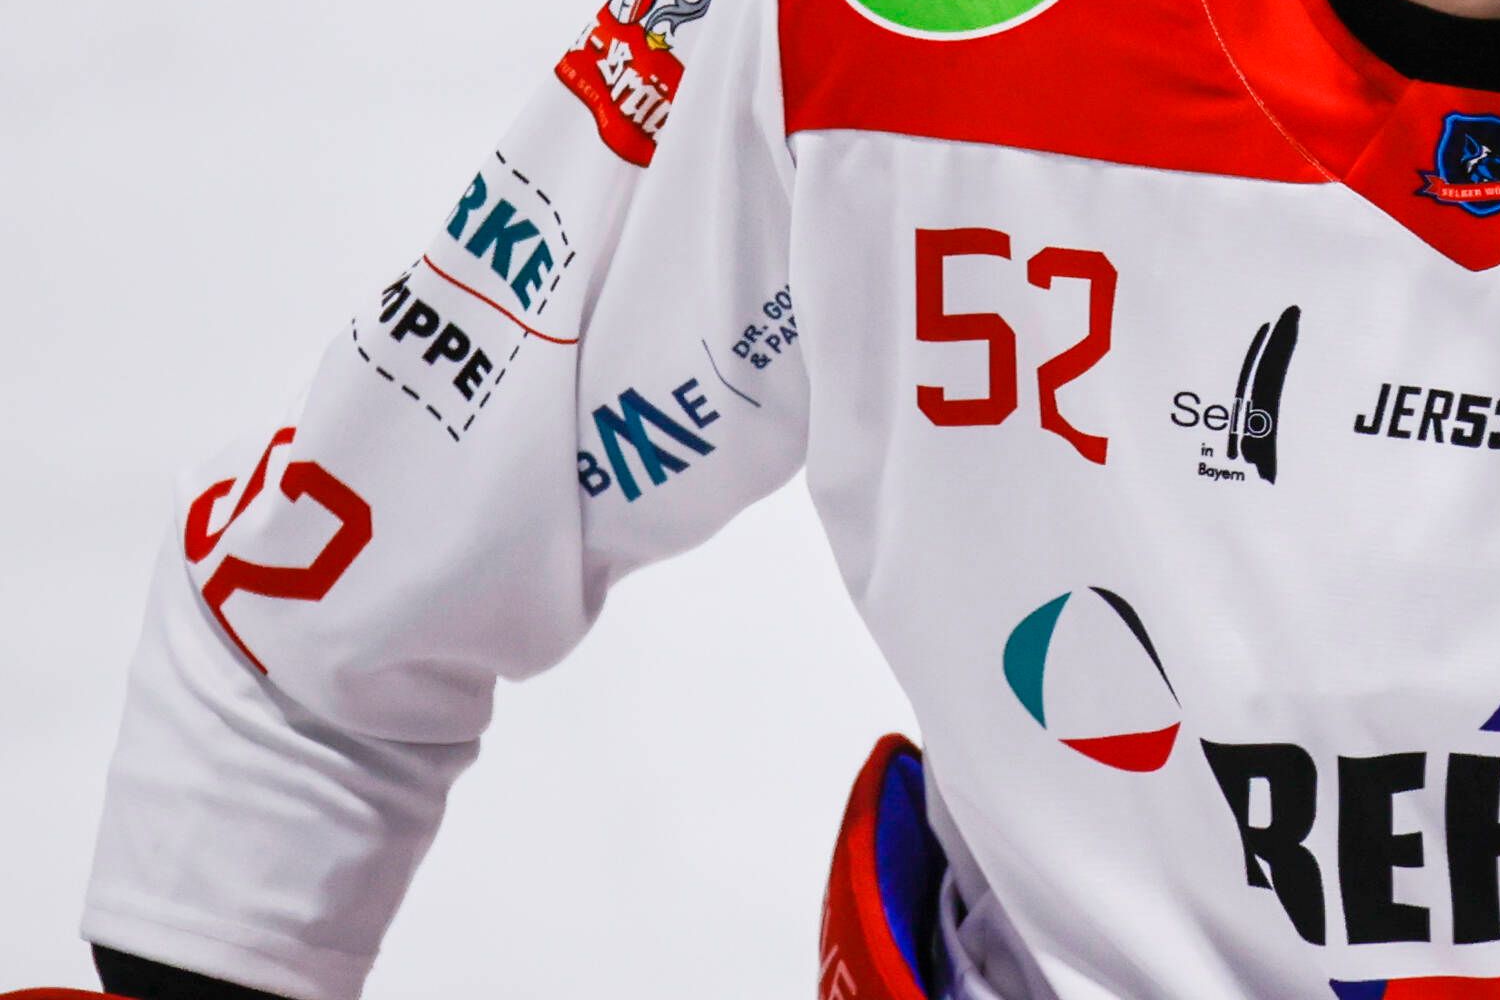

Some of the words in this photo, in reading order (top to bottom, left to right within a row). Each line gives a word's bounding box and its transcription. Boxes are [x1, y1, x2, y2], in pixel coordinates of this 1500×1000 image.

[731, 324, 768, 359] DR.
[763, 284, 793, 320] GO
[750, 352, 772, 370] &
[765, 315, 798, 354] PA
[915, 227, 1118, 465] 52
[1171, 391, 1273, 438] Selb
[1198, 462, 1245, 482] Bayern
[1200, 442, 1214, 457] in
